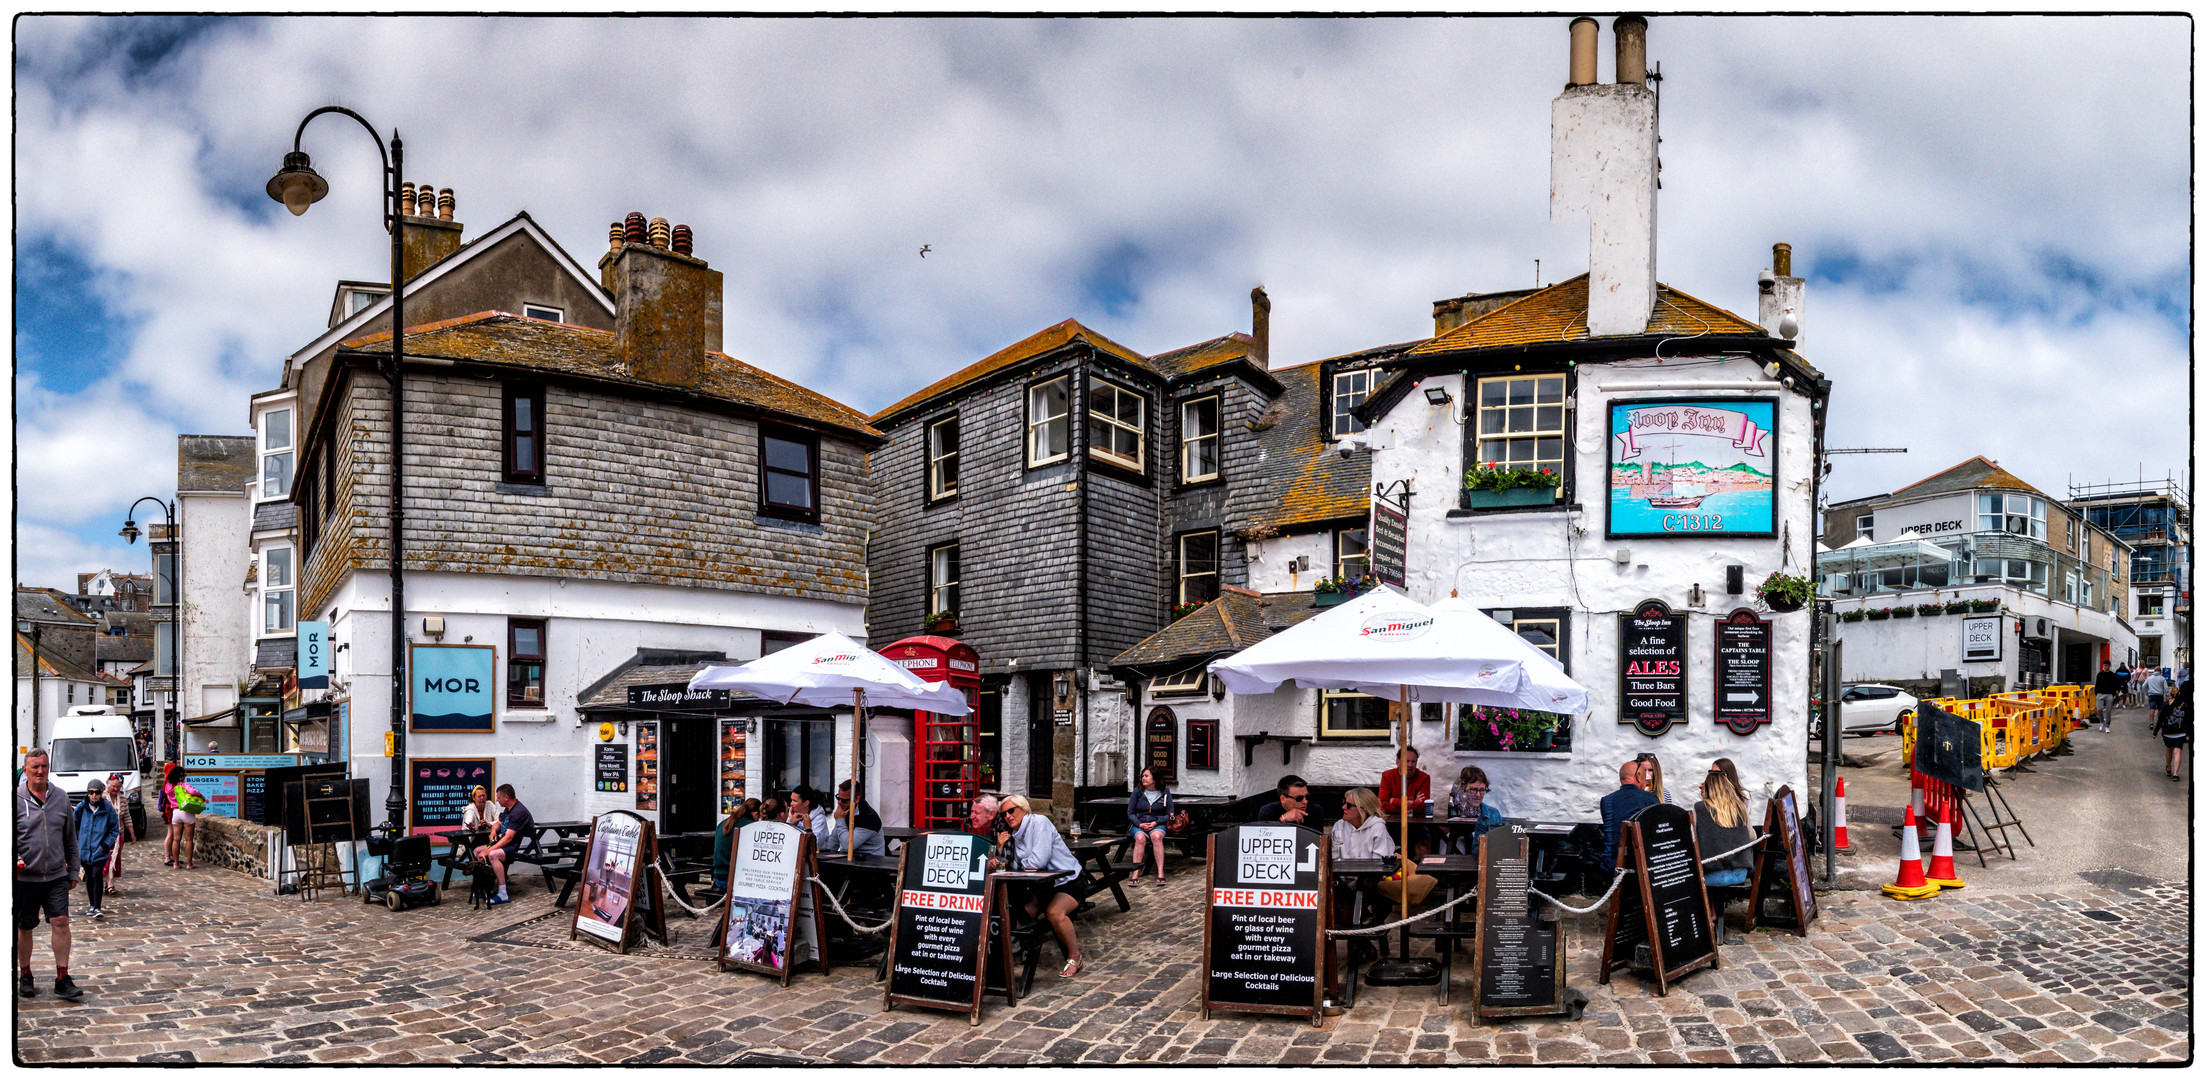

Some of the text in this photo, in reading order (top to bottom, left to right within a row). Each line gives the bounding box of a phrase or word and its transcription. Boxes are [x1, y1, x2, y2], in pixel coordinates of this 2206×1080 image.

[1901, 519, 1963, 535] UPPER DECK
[1633, 619, 1672, 628] The Sloop Inn
[1968, 621, 1994, 631] UPPER
[1640, 636, 1666, 645] A fine
[1969, 633, 1993, 642] DECK
[309, 632, 319, 667] MOR
[1628, 646, 1677, 655] selection of
[897, 659, 936, 669] LEPHONE
[950, 658, 975, 670] TELEPHONE
[1626, 660, 1681, 675] ALES
[425, 677, 481, 694] MOR
[1630, 681, 1675, 690] Three Bars
[641, 690, 657, 703] The
[657, 688, 683, 705] Sloop
[683, 688, 712, 700] Shack
[1630, 698, 1676, 708] Good Food
[1153, 750, 1168, 758] GOOD
[186, 758, 217, 766] MOR
[1153, 759, 1168, 767] FOOD
[1511, 824, 1527, 834] The
[753, 830, 786, 845] UPPER
[1241, 838, 1293, 855] UPPER
[752, 848, 782, 864] DECK
[927, 845, 969, 862] UPPER
[926, 868, 966, 885] DECK
[1243, 863, 1291, 880] DECK
[768, 885, 790, 893] COCKTAILS
[902, 891, 985, 912] FREE DRINK
[1213, 890, 1318, 908] FREE DRINK
[915, 914, 966, 926] Pint of local beer
[1231, 914, 1296, 924] Pint of local beer
[924, 924, 940, 933] glass
[948, 927, 964, 935] wine
[1244, 924, 1264, 933] glass
[1265, 925, 1275, 933] of
[1275, 925, 1295, 934] wine
[923, 933, 956, 944] with every
[1244, 933, 1285, 944] with every
[917, 942, 961, 953] gourmet pizza
[1237, 944, 1292, 953] gourmet pizza
[911, 949, 922, 957] eat
[937, 953, 964, 963] takeway
[1230, 952, 1243, 960] eat
[1244, 952, 1252, 960] in
[1263, 953, 1297, 964] takeway
[894, 963, 976, 982] Large Selection of Delicious
[1211, 969, 1315, 983] Large Selection of Delicious
[920, 976, 948, 987] Cocktails
[1244, 981, 1280, 990] Cocktails
